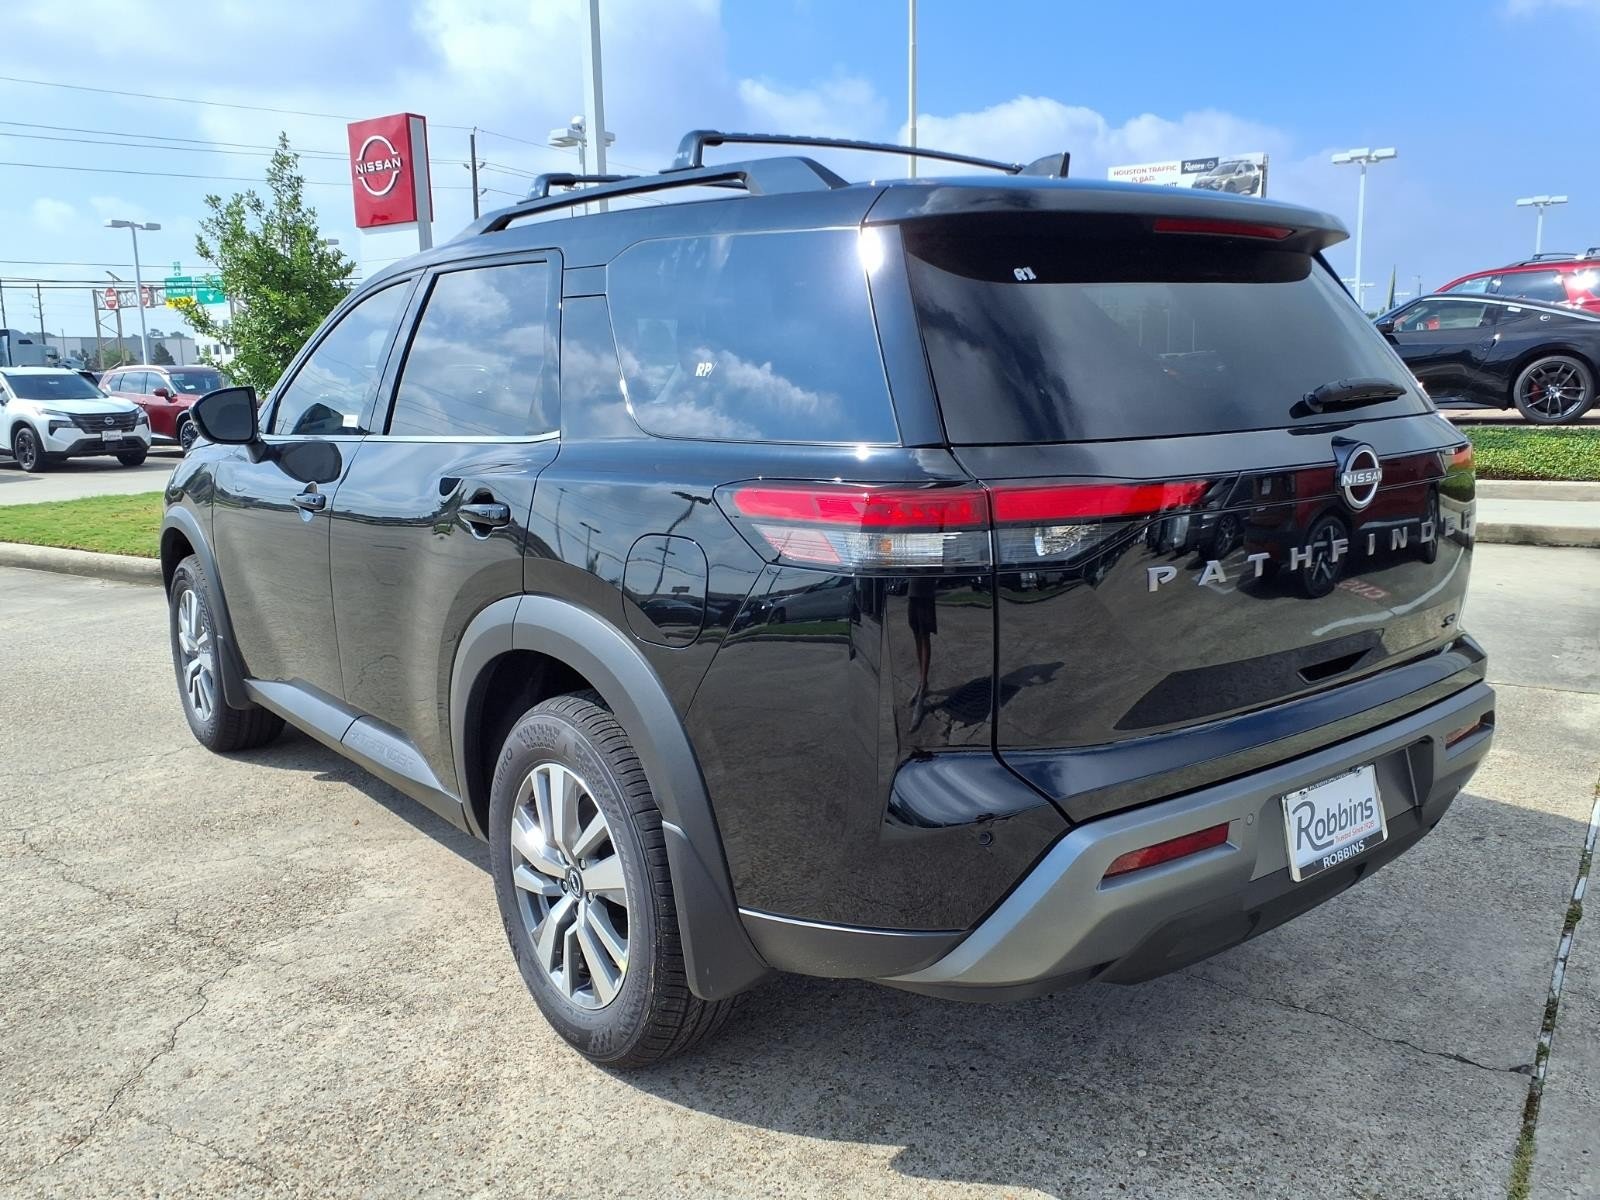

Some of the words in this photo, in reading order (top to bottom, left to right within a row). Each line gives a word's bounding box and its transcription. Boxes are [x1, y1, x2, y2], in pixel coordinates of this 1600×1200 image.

[355, 157, 402, 175] NISSAN
[1113, 168, 1147, 176] HOUSTON
[1148, 165, 1177, 173] TRAFFIC
[1343, 469, 1382, 485] NISSAN
[1147, 509, 1475, 593] PATHFINDER
[1292, 797, 1374, 852] Robbins
[1323, 839, 1366, 869] ROBBINS
